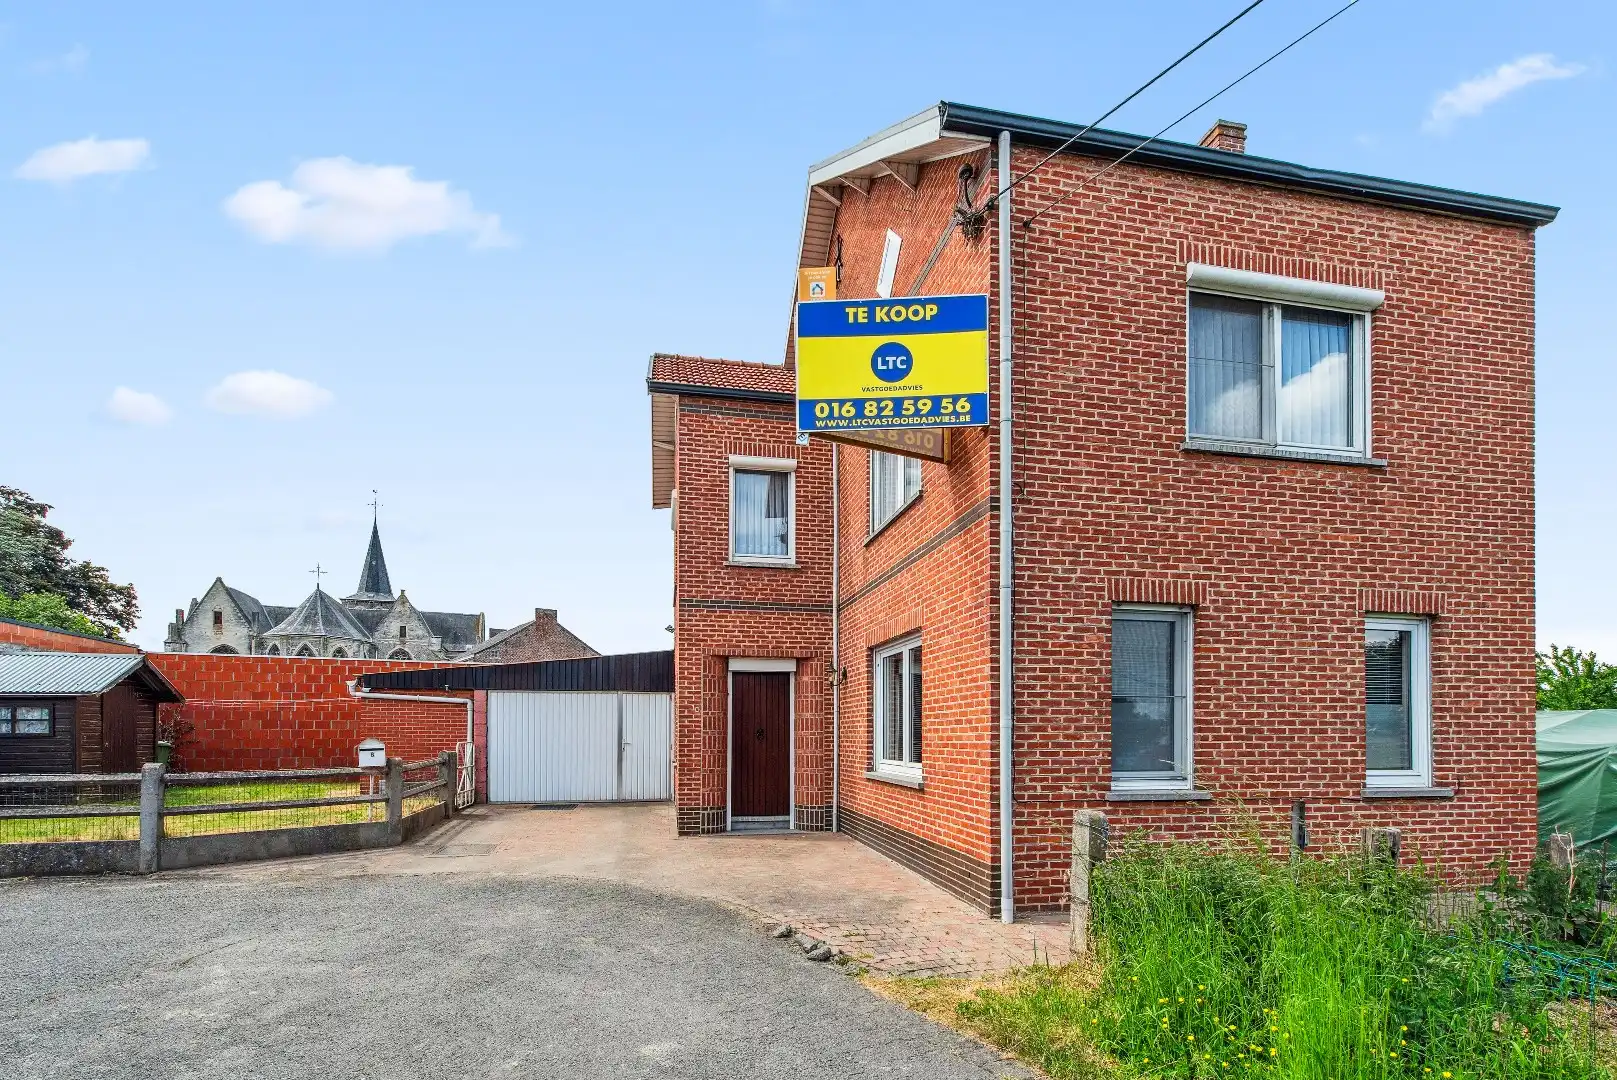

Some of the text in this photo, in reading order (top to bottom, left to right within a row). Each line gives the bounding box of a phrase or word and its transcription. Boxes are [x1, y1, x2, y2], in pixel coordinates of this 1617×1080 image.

[845, 304, 938, 323] TE KOOP
[877, 356, 907, 370] LTC
[861, 385, 923, 393] VASTGOEDADVIES
[814, 397, 971, 418] 016 82 59 56
[815, 414, 971, 427] WWW.LTCVASTGOEDADVIES.BE
